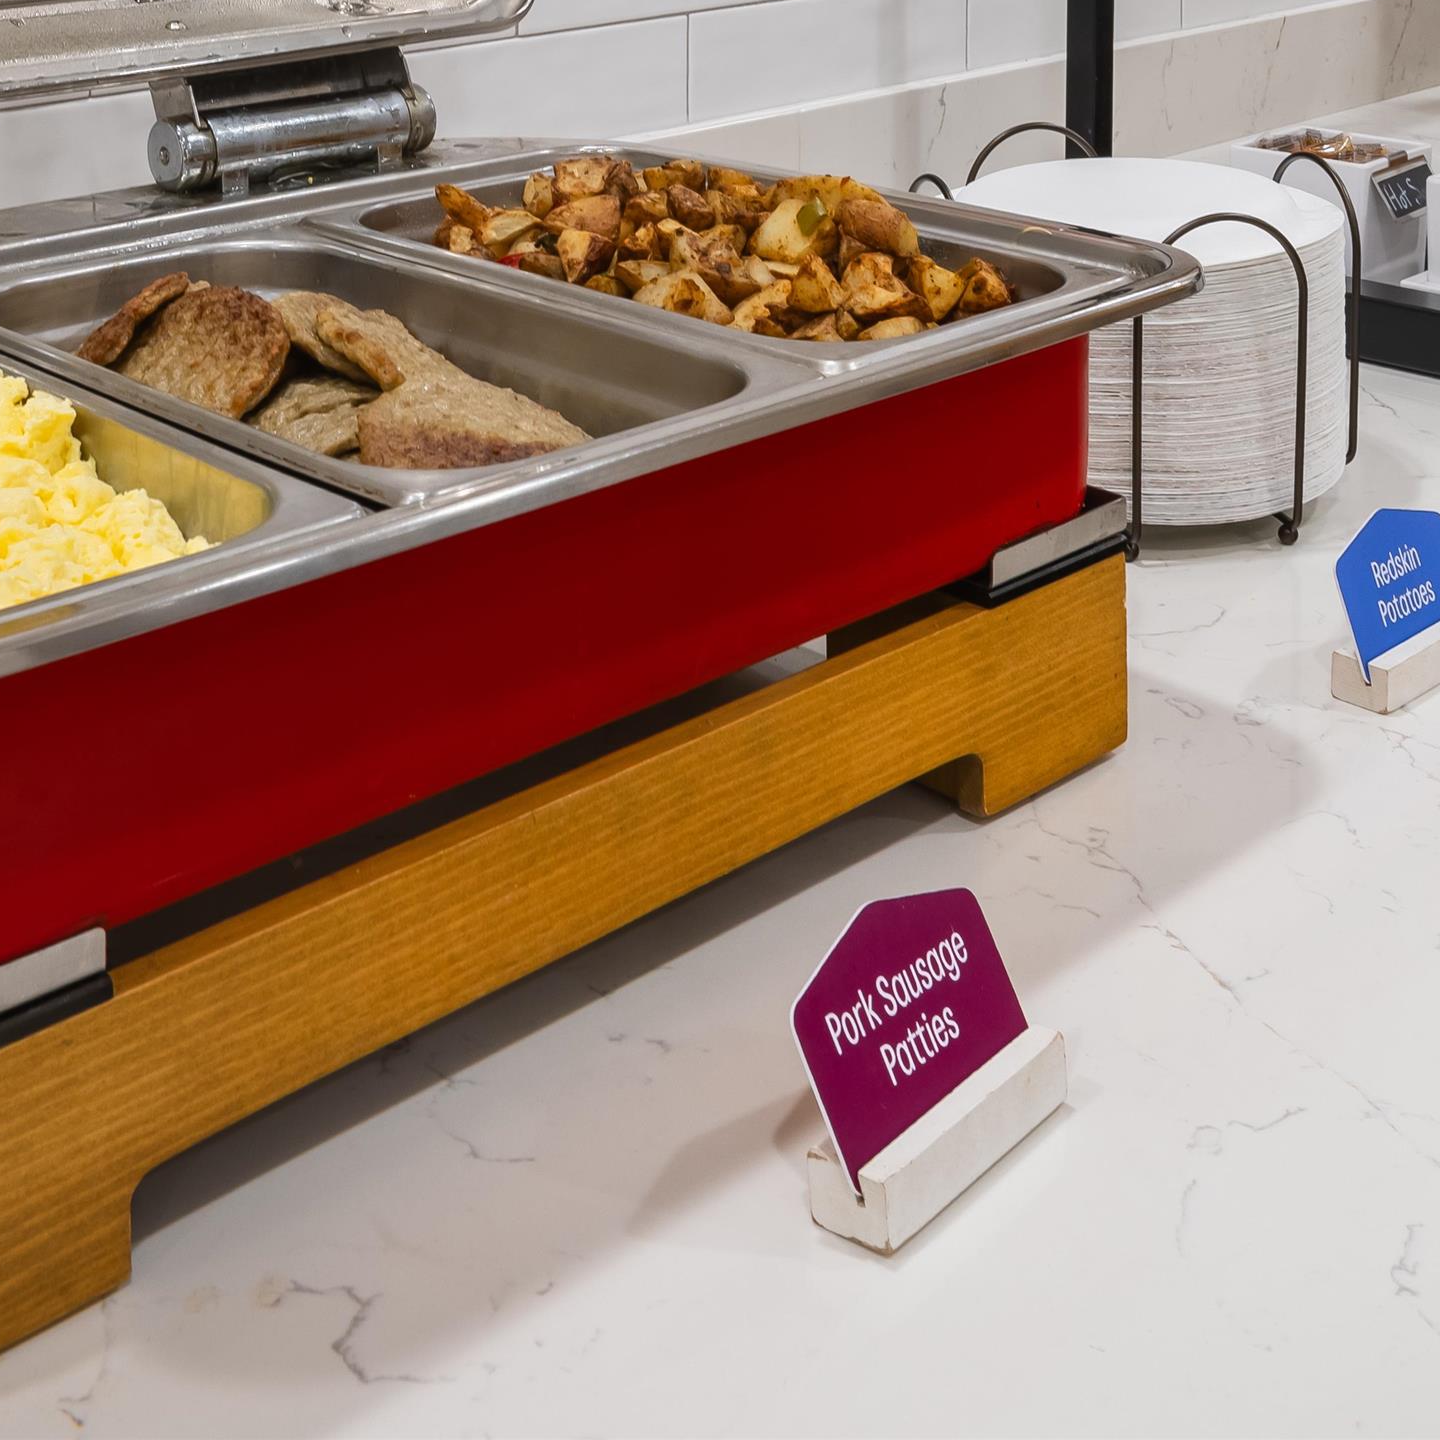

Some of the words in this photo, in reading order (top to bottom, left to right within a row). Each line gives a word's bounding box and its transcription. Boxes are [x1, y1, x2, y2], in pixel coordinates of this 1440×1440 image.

[1382, 182, 1413, 211] Hot
[1370, 543, 1422, 589] Redskin
[1377, 580, 1436, 628] Potatoes
[824, 989, 883, 1056] Pork
[874, 930, 969, 1017] Sausage
[879, 1006, 961, 1087] Patties
